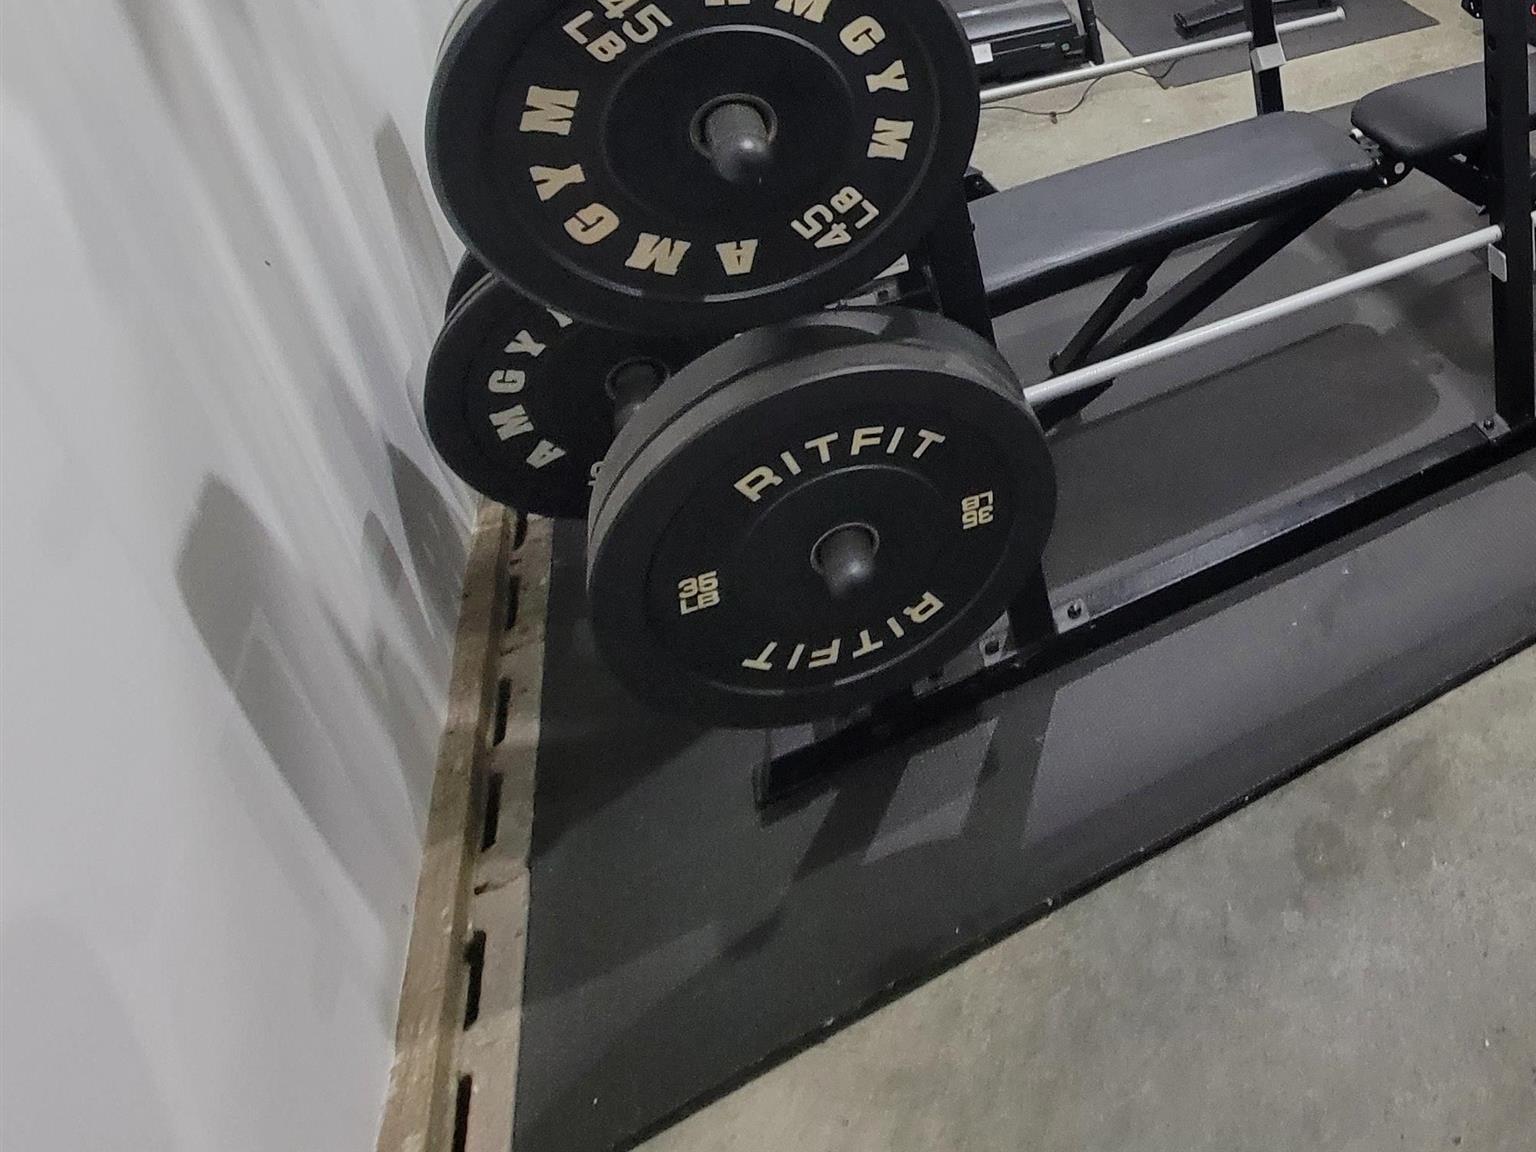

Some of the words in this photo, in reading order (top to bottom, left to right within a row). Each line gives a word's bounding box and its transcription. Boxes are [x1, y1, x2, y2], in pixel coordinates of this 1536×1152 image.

[562, 10, 627, 63] LB
[519, 85, 758, 277] AMGYM
[790, 204, 852, 249] 45
[830, 186, 880, 230] LB
[733, 426, 946, 503] RITFIT
[961, 490, 994, 513] LB
[680, 591, 720, 615] LB
[742, 591, 944, 671] RITFIT
